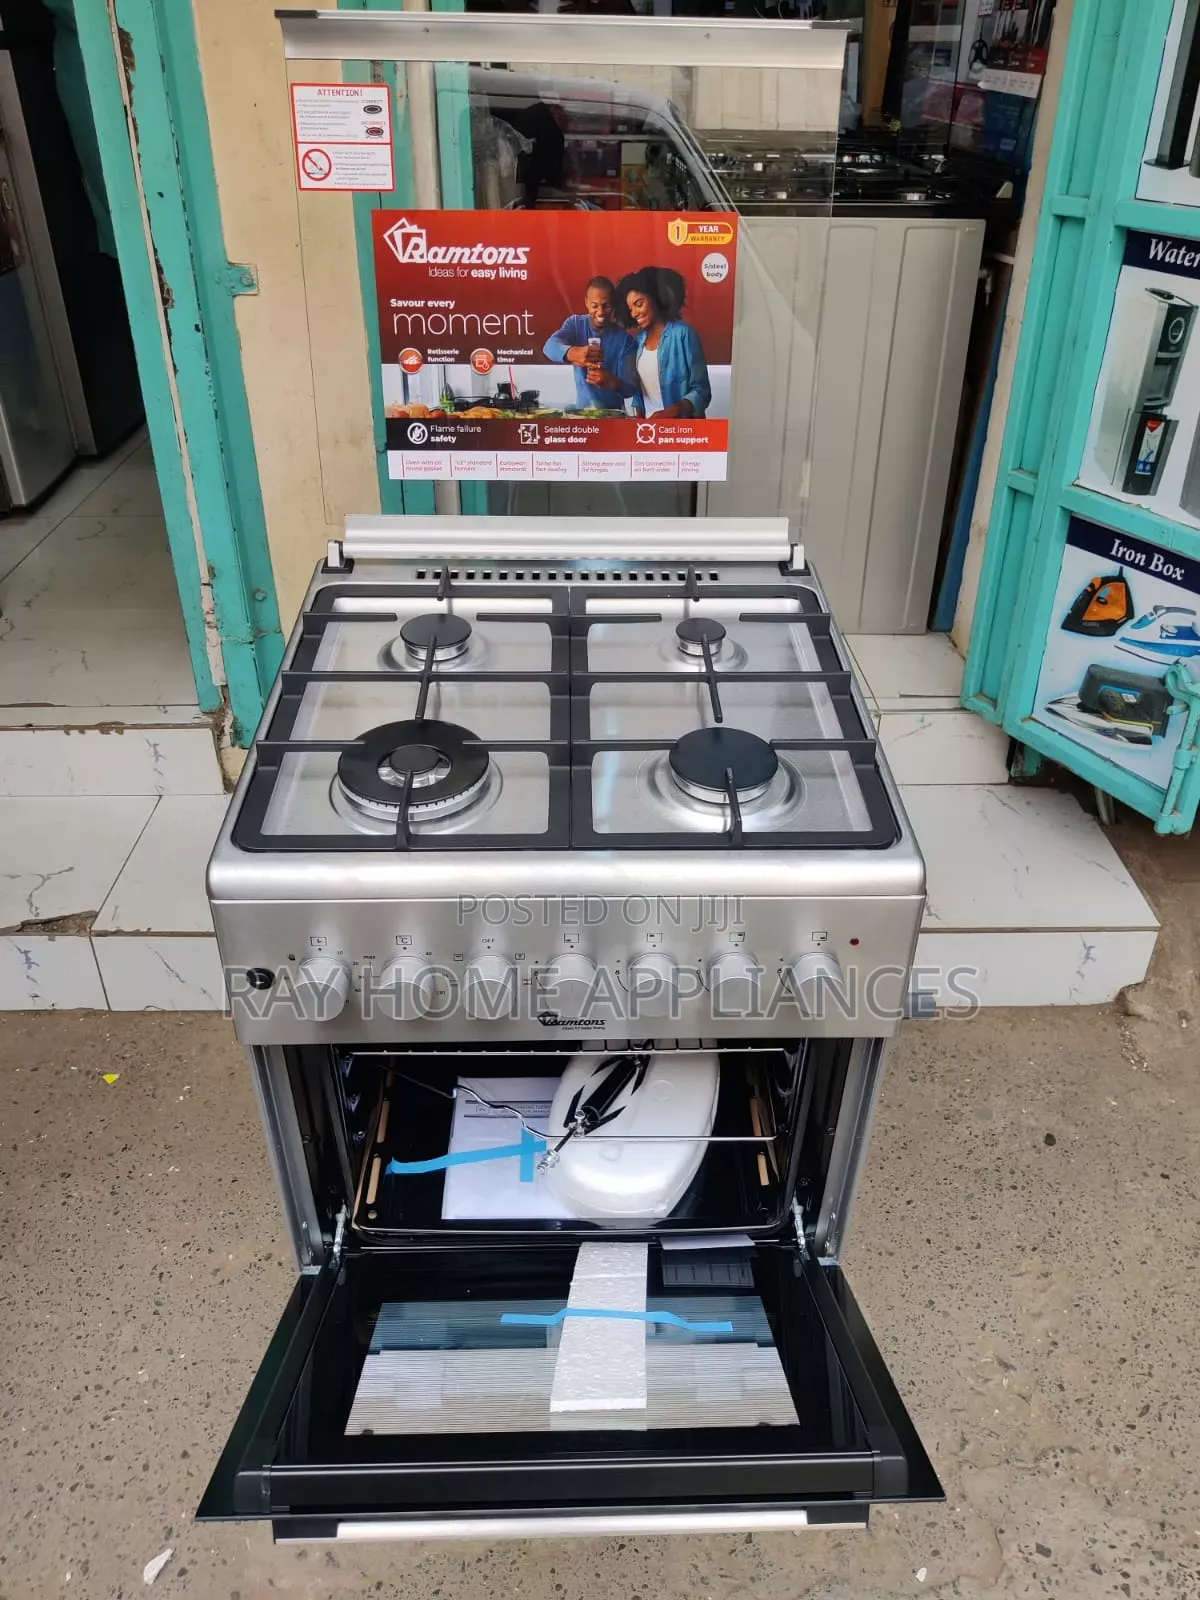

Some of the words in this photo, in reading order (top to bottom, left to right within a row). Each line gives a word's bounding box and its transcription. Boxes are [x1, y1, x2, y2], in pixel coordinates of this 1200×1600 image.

[317, 89, 363, 97] ATTENTION!
[698, 225, 719, 233] YEAR
[400, 233, 531, 265] Ramtons
[428, 266, 454, 278] Ideas
[456, 266, 468, 278] for
[471, 268, 496, 280] easy
[499, 266, 527, 280] living
[390, 298, 425, 308] Savour
[427, 299, 456, 310] every
[393, 309, 536, 335] moment
[430, 425, 455, 433] Flame
[456, 425, 482, 433] failure
[544, 425, 570, 434] Sealed
[571, 426, 600, 434] double
[659, 426, 676, 434] Cast
[677, 426, 693, 434] iron
[430, 435, 457, 444] safety
[544, 436, 566, 445] glass
[567, 436, 587, 444] door
[658, 437, 675, 445] pan
[676, 436, 709, 445] support
[1109, 538, 1147, 566] Iron
[1148, 552, 1185, 581] Box
[543, 1014, 607, 1026] Ramtons
